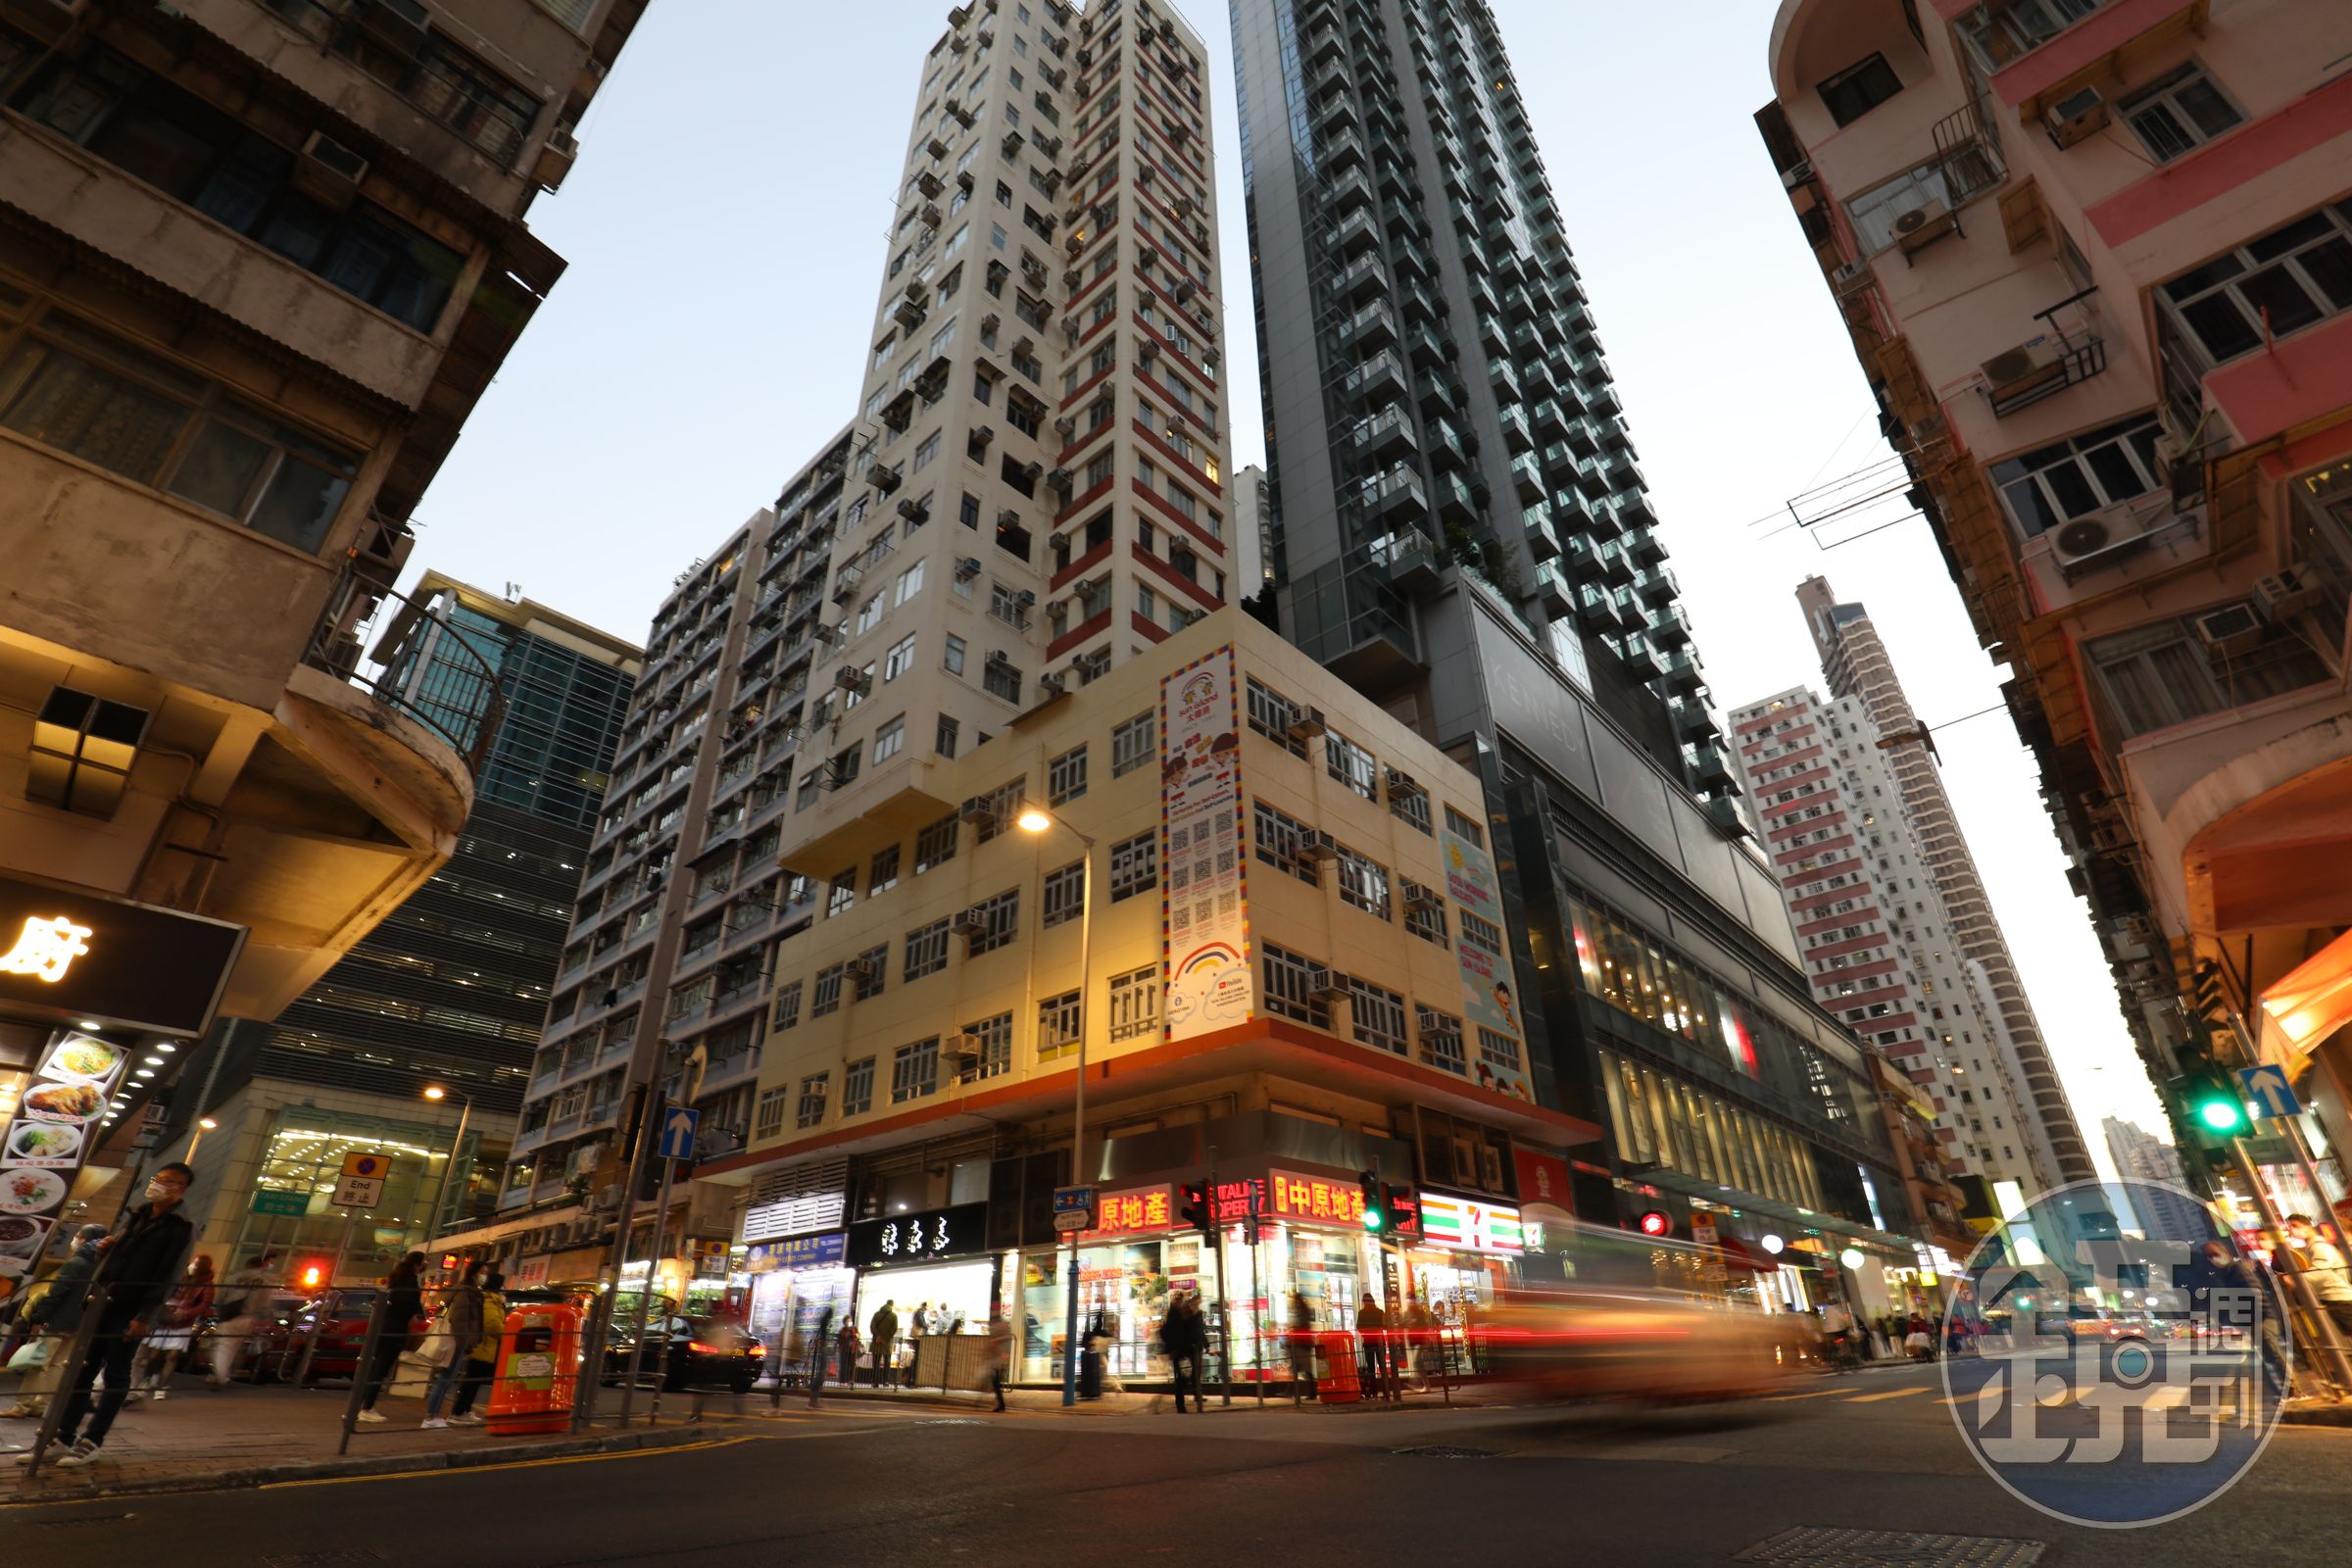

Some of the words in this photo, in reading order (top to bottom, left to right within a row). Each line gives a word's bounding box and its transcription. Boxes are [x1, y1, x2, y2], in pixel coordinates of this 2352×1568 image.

[350, 1180, 371, 1191] End
[1289, 1179, 1366, 1222] 中原地產
[1099, 1192, 1169, 1231] 原地產
